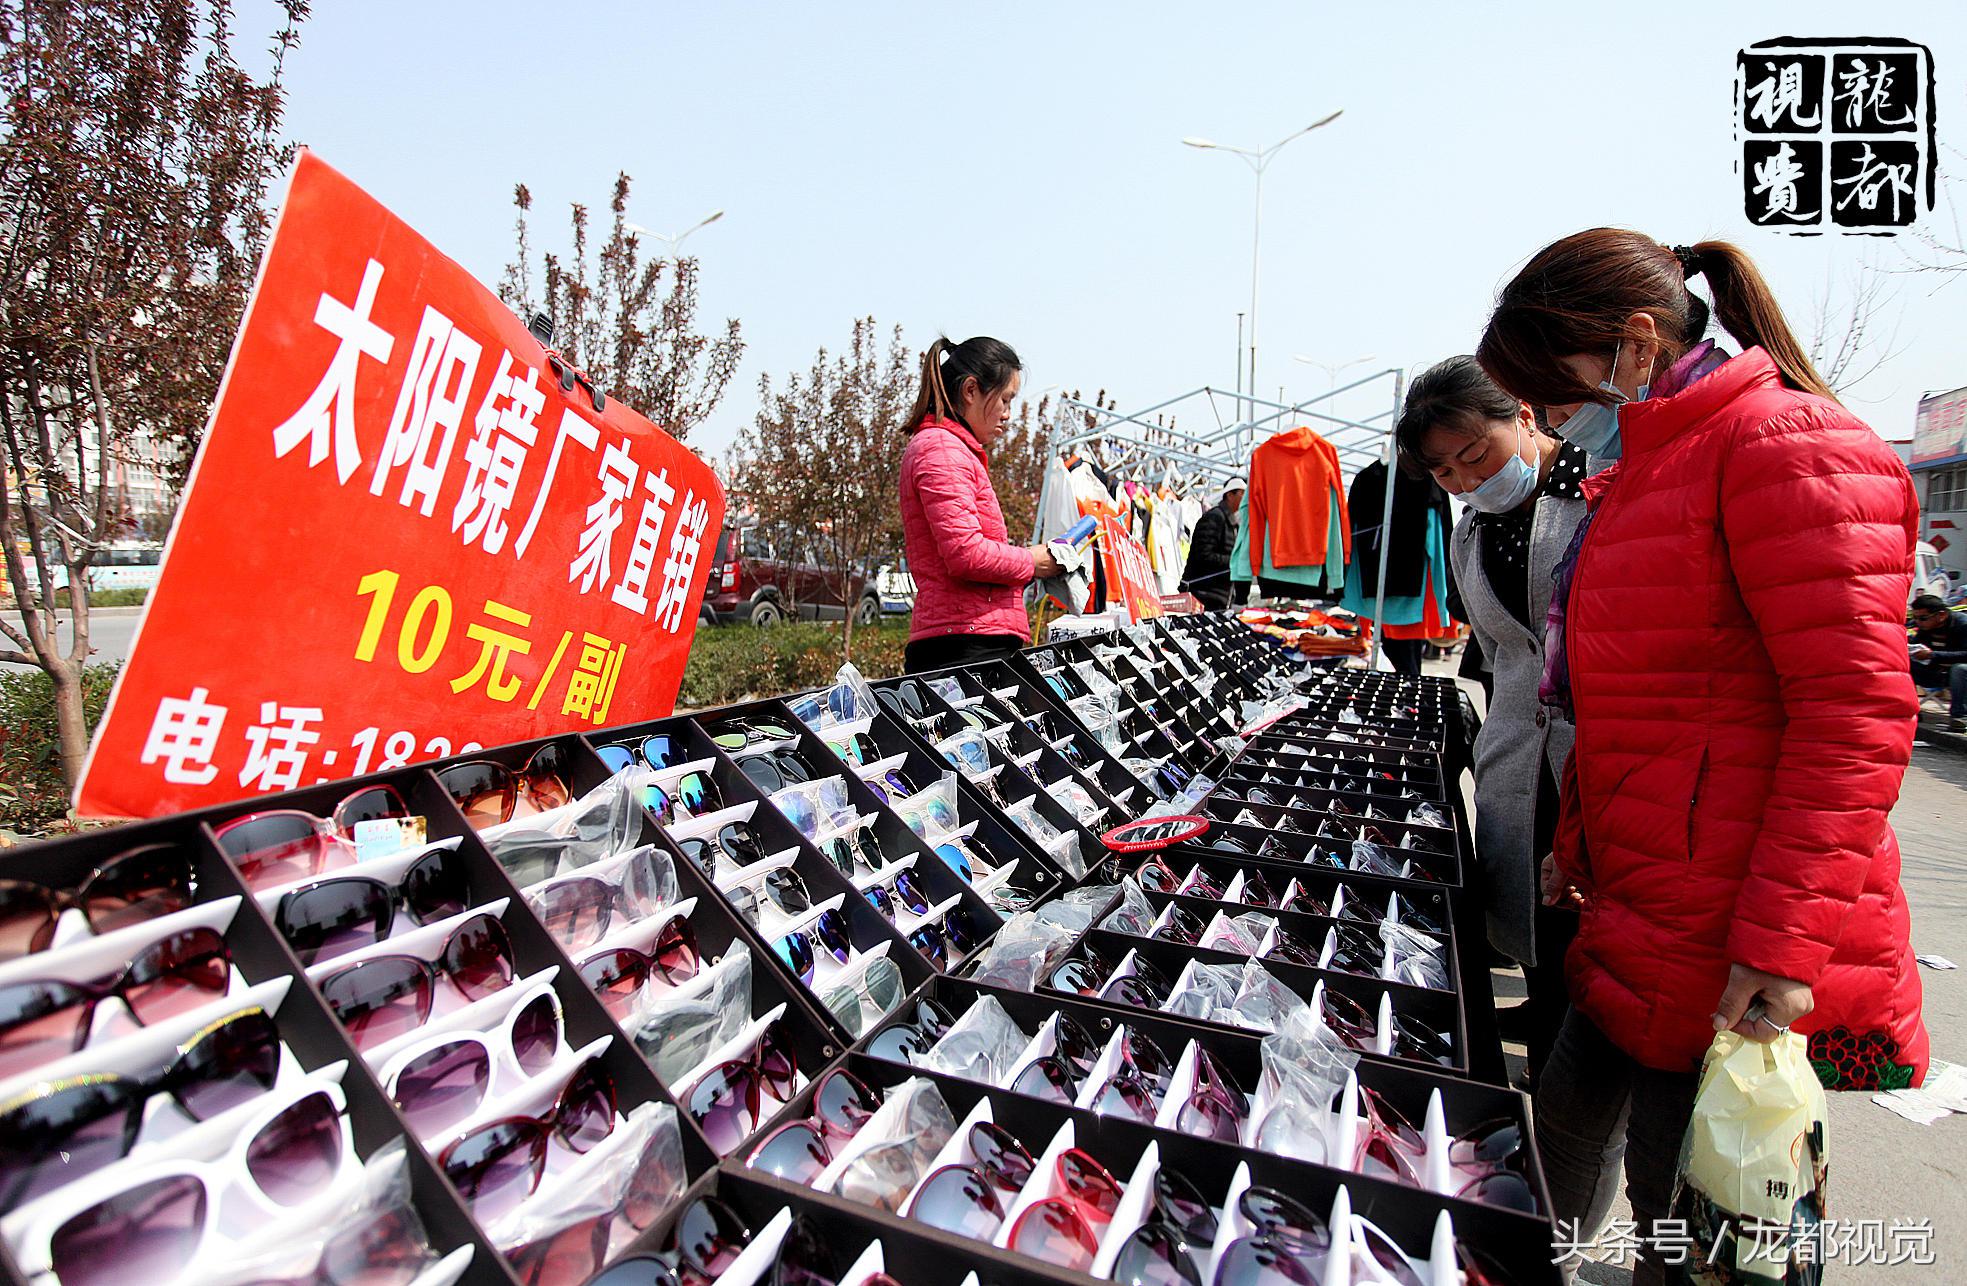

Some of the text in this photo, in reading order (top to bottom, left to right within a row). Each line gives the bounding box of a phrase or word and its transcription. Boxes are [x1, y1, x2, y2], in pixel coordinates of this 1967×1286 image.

[272, 256, 711, 635] 太阳镜厂家直销
[141, 687, 483, 791] 电话:18
